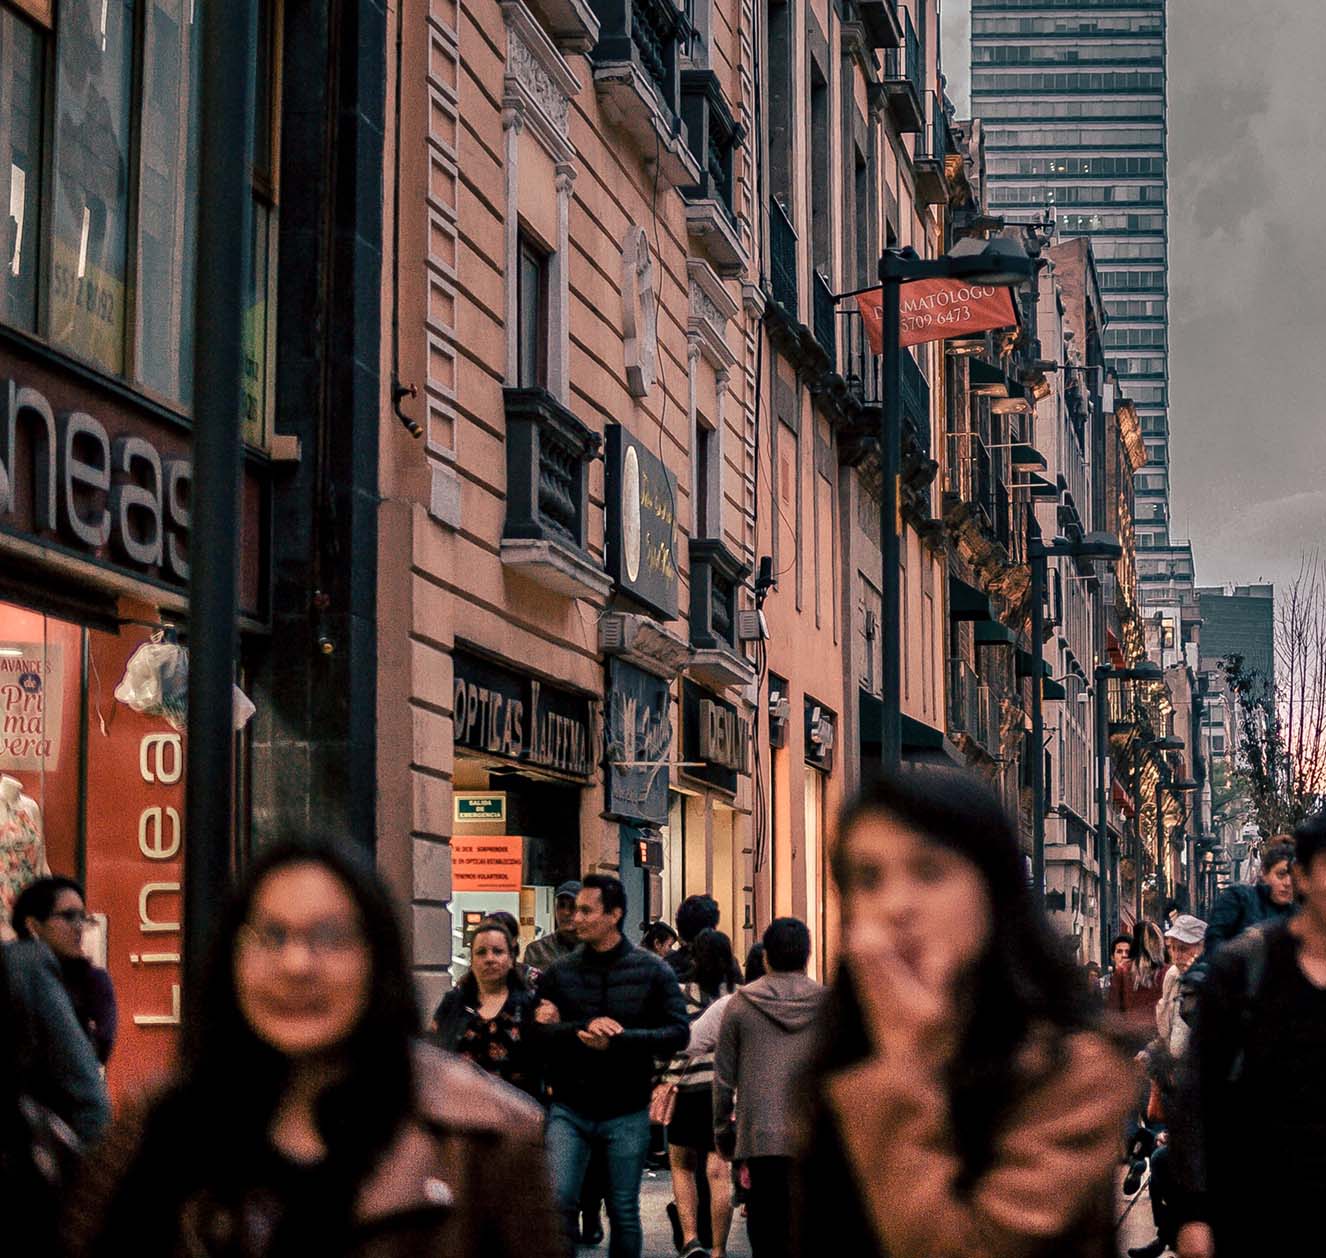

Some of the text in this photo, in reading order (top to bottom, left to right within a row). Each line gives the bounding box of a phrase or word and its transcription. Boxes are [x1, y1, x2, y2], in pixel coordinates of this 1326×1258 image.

[873, 285, 995, 321] DMATÓLOGO
[901, 305, 971, 333] 5709 6473
[0, 658, 52, 674] AVANCES
[1, 684, 42, 712] Pri
[3, 714, 42, 734] ma
[454, 677, 523, 758] OPTICAS
[129, 732, 183, 1025] Linea
